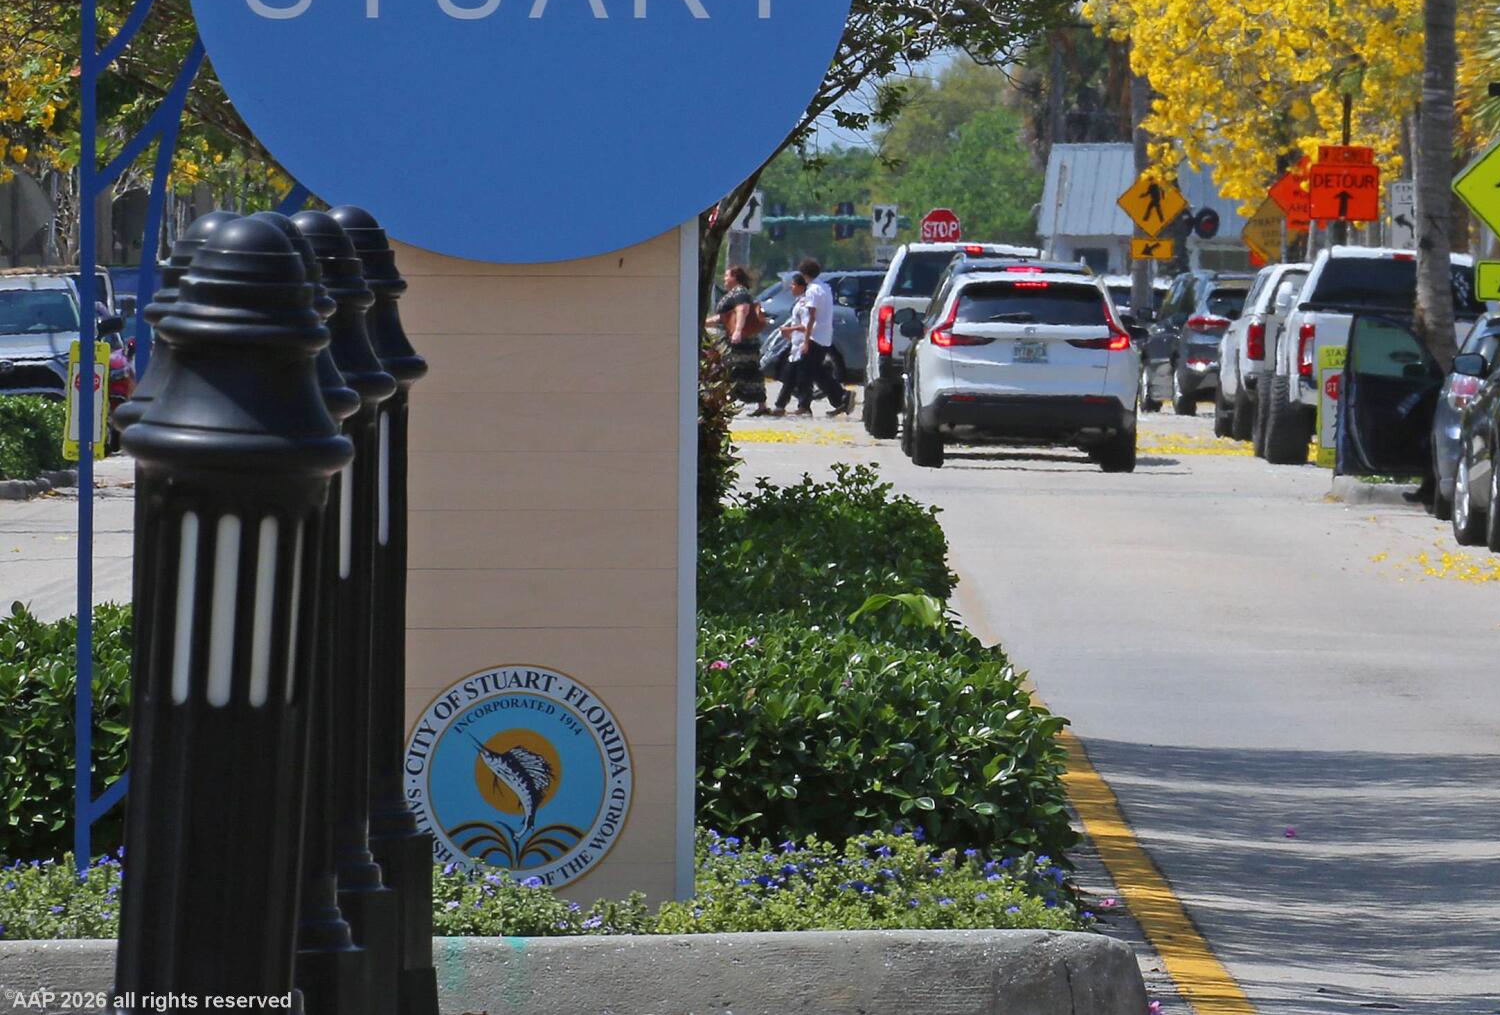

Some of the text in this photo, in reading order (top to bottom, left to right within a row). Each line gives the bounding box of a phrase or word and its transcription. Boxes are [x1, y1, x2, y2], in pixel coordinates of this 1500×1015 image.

[1313, 173, 1375, 189] DETOUR
[923, 220, 958, 238] STOP
[405, 670, 627, 778] CITY OF STUART FLORIDA
[453, 698, 584, 736] INCORPORATED 1914
[556, 849, 593, 880] THE
[589, 787, 626, 850] WORLD
